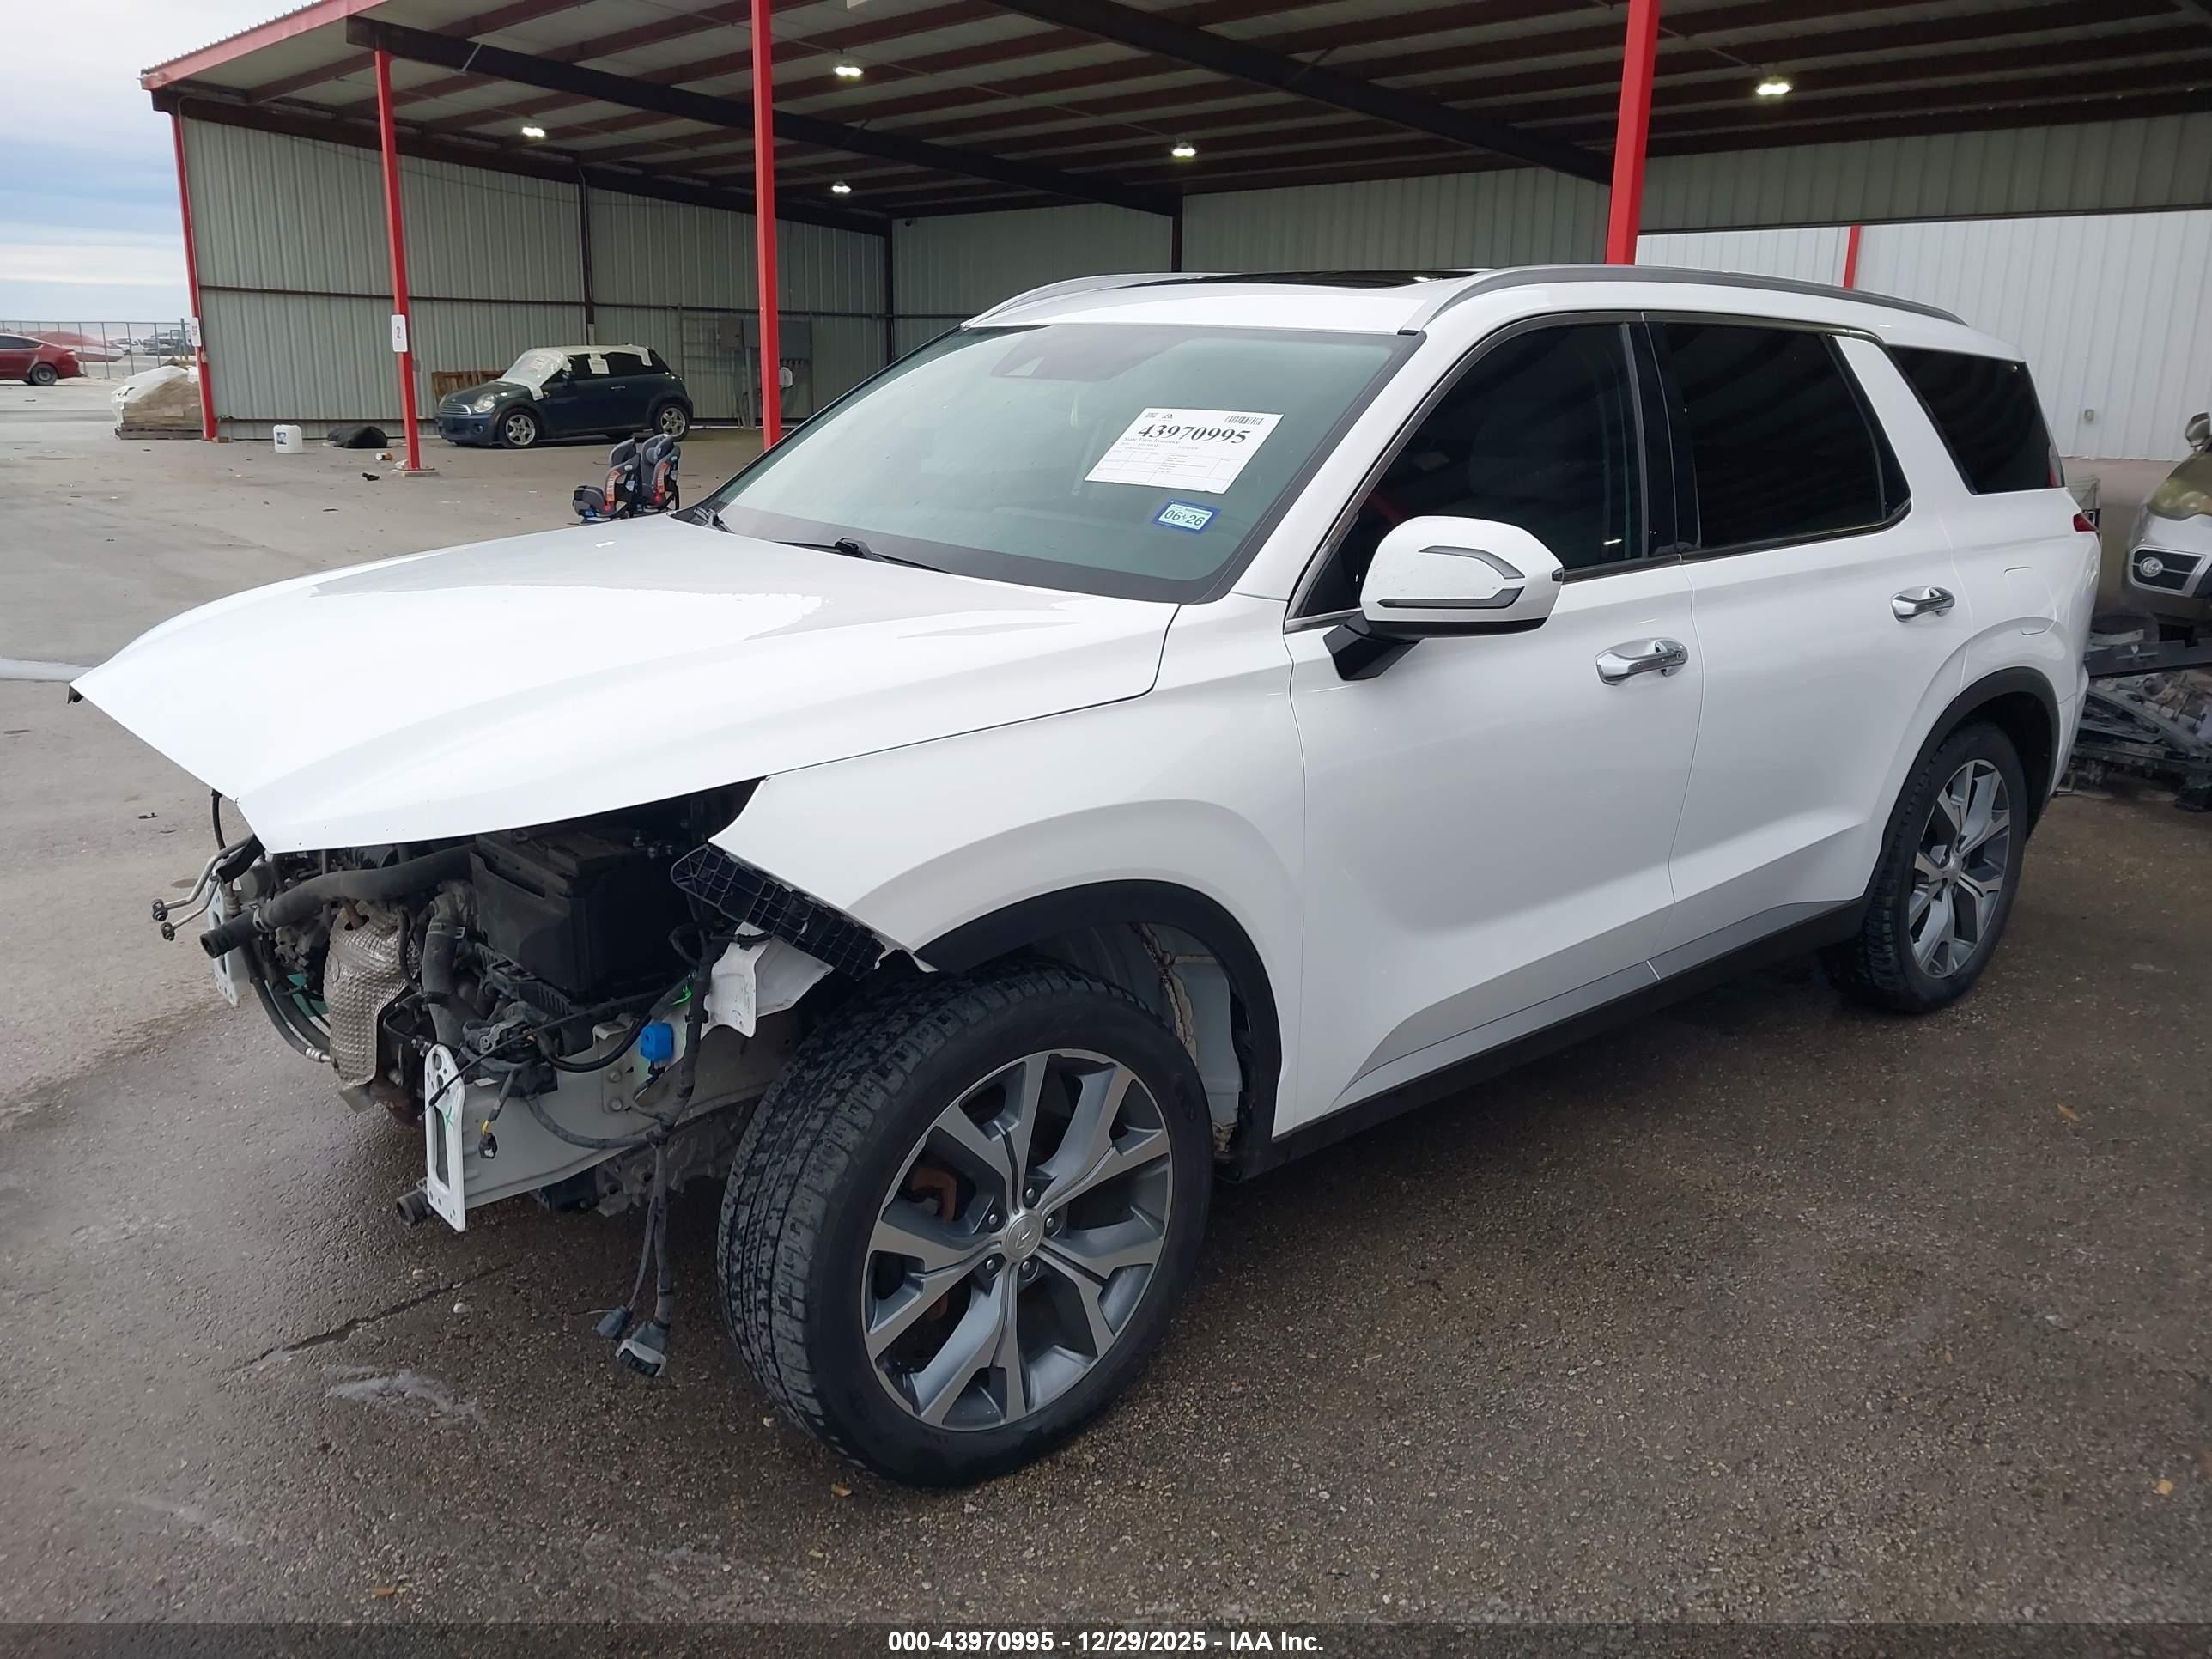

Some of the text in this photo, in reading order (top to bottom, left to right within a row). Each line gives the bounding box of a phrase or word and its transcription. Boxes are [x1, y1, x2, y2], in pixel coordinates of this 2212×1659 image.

[396, 325, 401, 338] 2
[1138, 424, 1251, 444] 43970995
[1164, 509, 1184, 521] 06
[1185, 514, 1206, 526] 26
